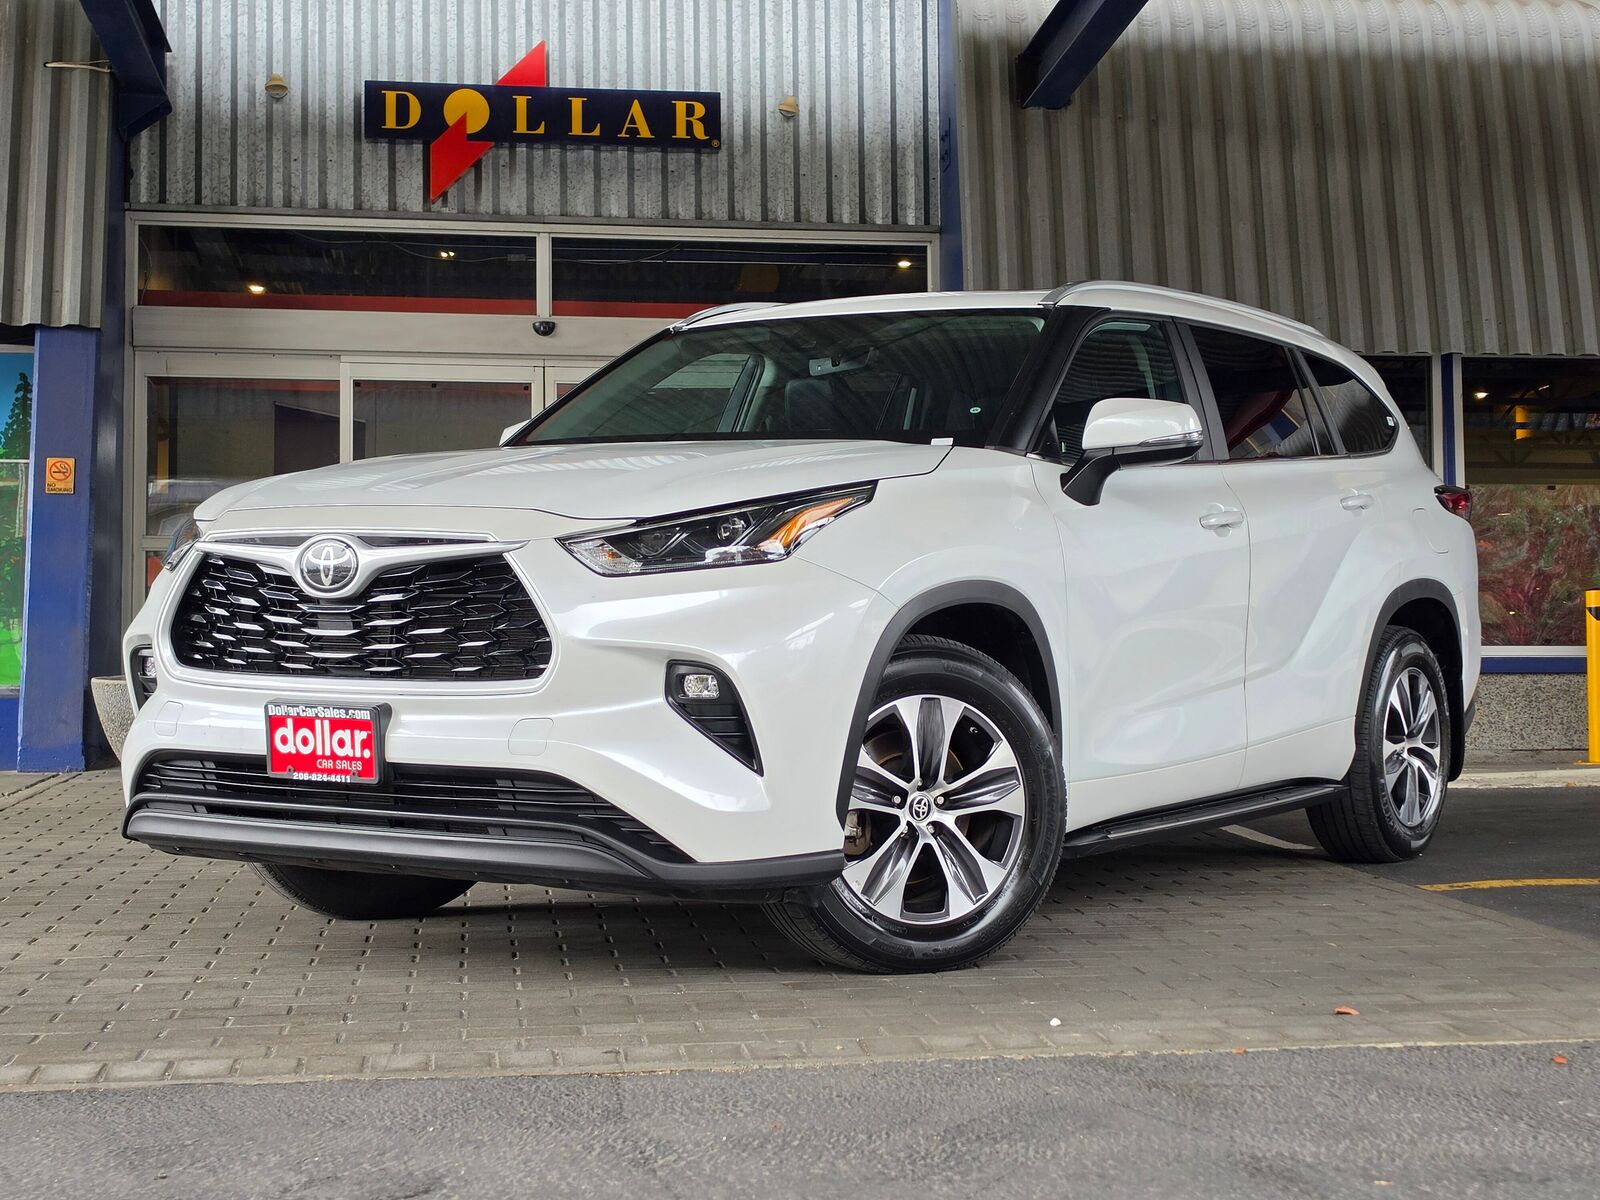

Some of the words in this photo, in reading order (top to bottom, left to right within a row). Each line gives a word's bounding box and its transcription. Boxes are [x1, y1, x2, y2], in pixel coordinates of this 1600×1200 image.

[381, 88, 709, 140] DOLLAR
[268, 704, 371, 720] DollarCarSales.com
[274, 718, 371, 758] dollar.
[316, 759, 334, 769] CAR
[336, 761, 362, 771] SALES
[293, 772, 351, 782] 206-824-4411
